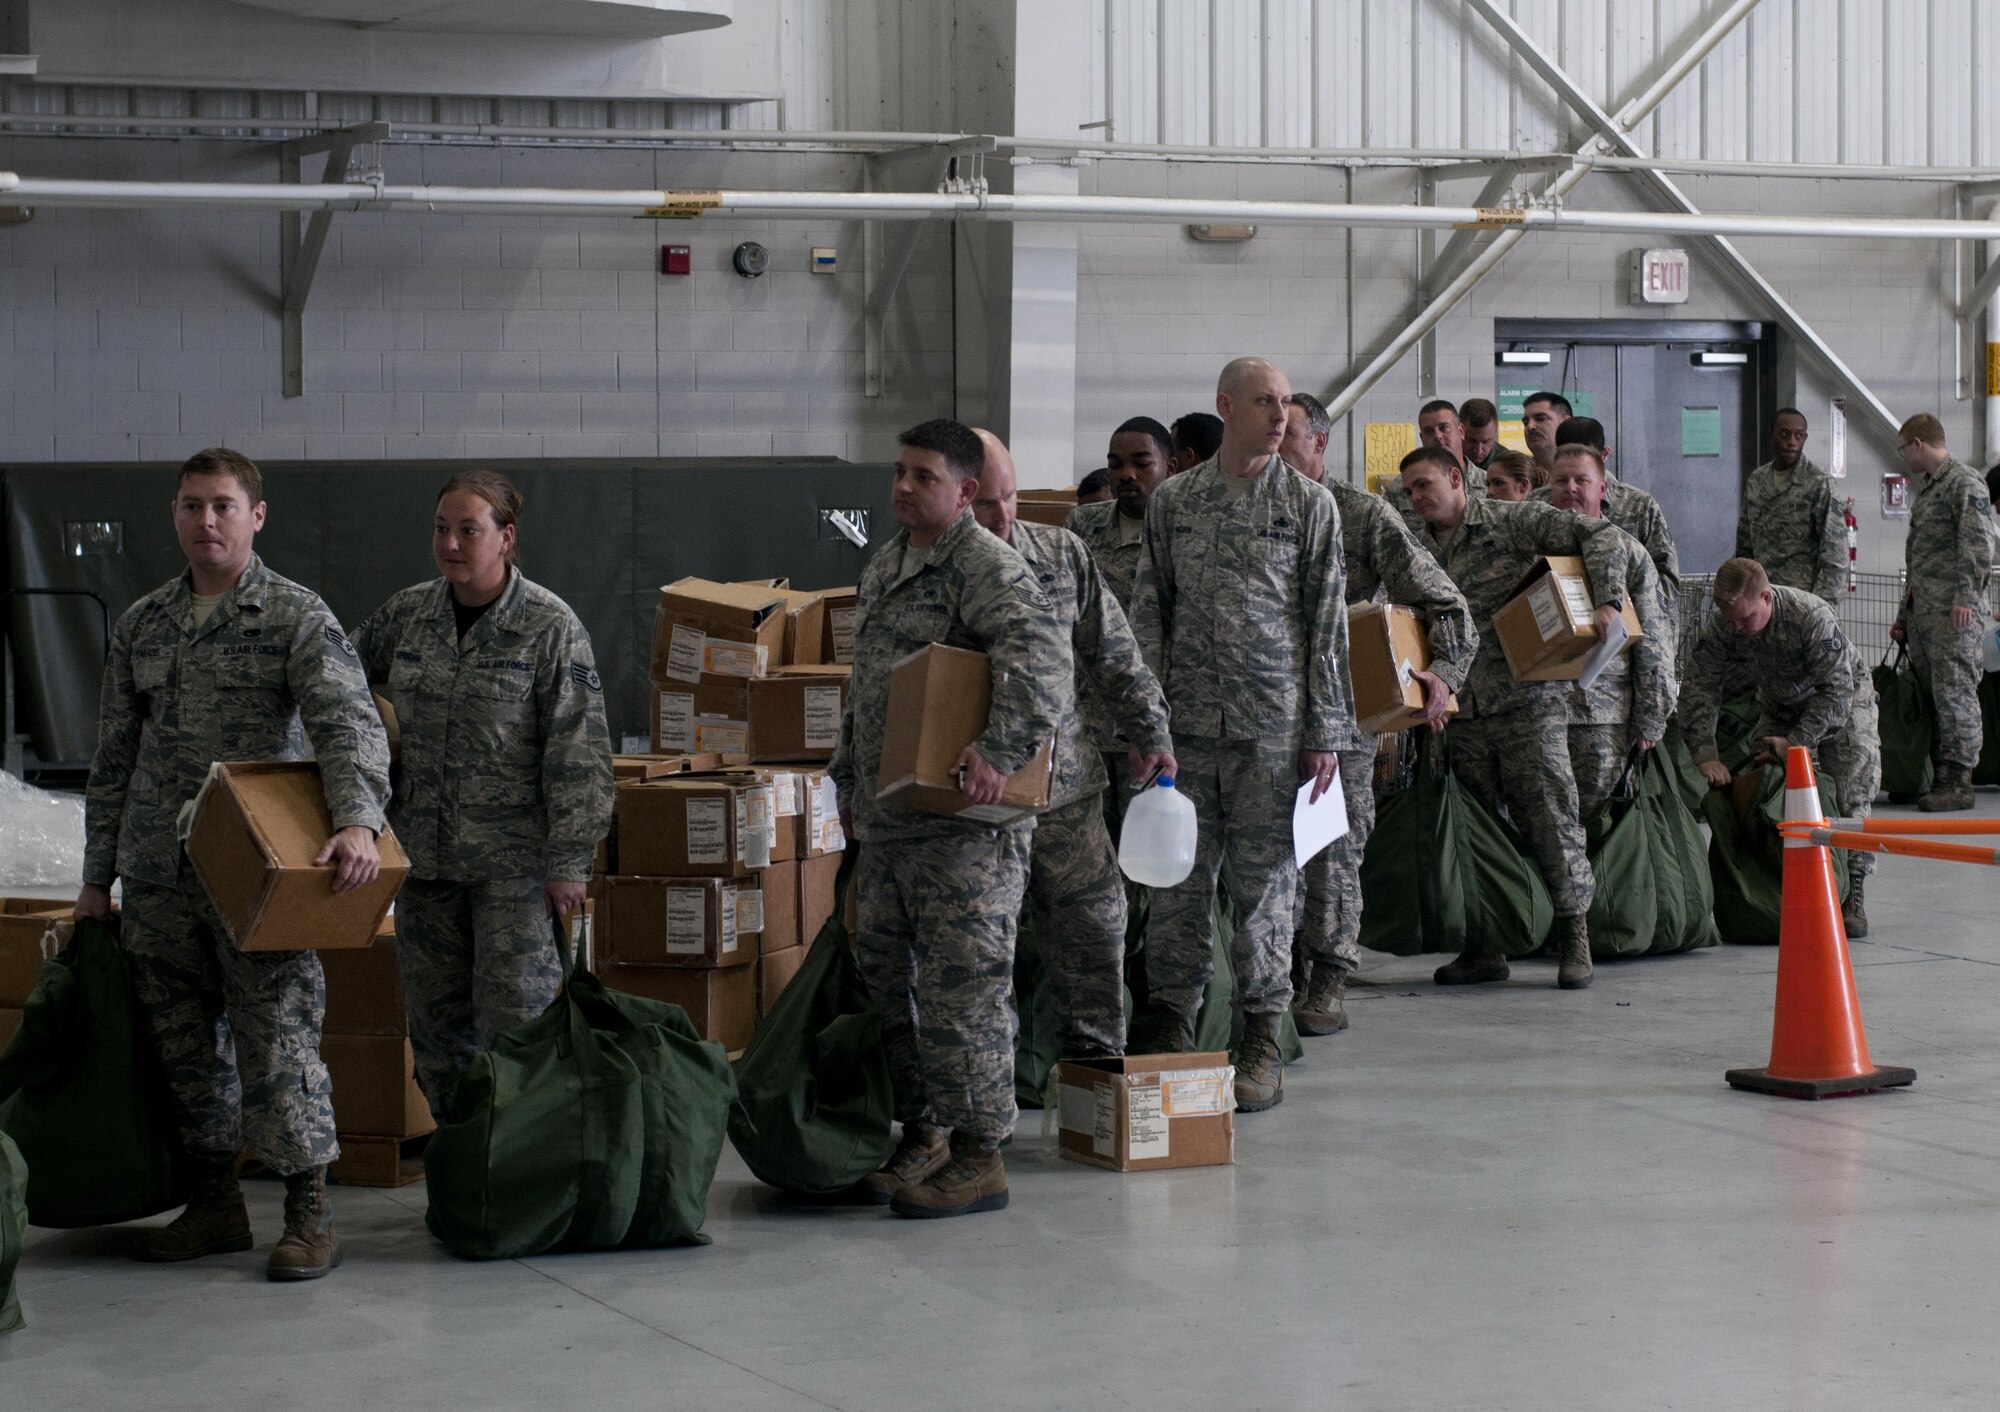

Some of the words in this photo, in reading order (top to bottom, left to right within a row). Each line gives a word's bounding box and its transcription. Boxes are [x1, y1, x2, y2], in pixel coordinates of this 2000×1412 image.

[1651, 262, 1683, 291] EXIT
[1371, 424, 1409, 440] START
[1374, 440, 1408, 456] FOAM
[253, 645, 282, 656] FORCE
[492, 660, 505, 669] AIR
[506, 661, 530, 672] FORCE
